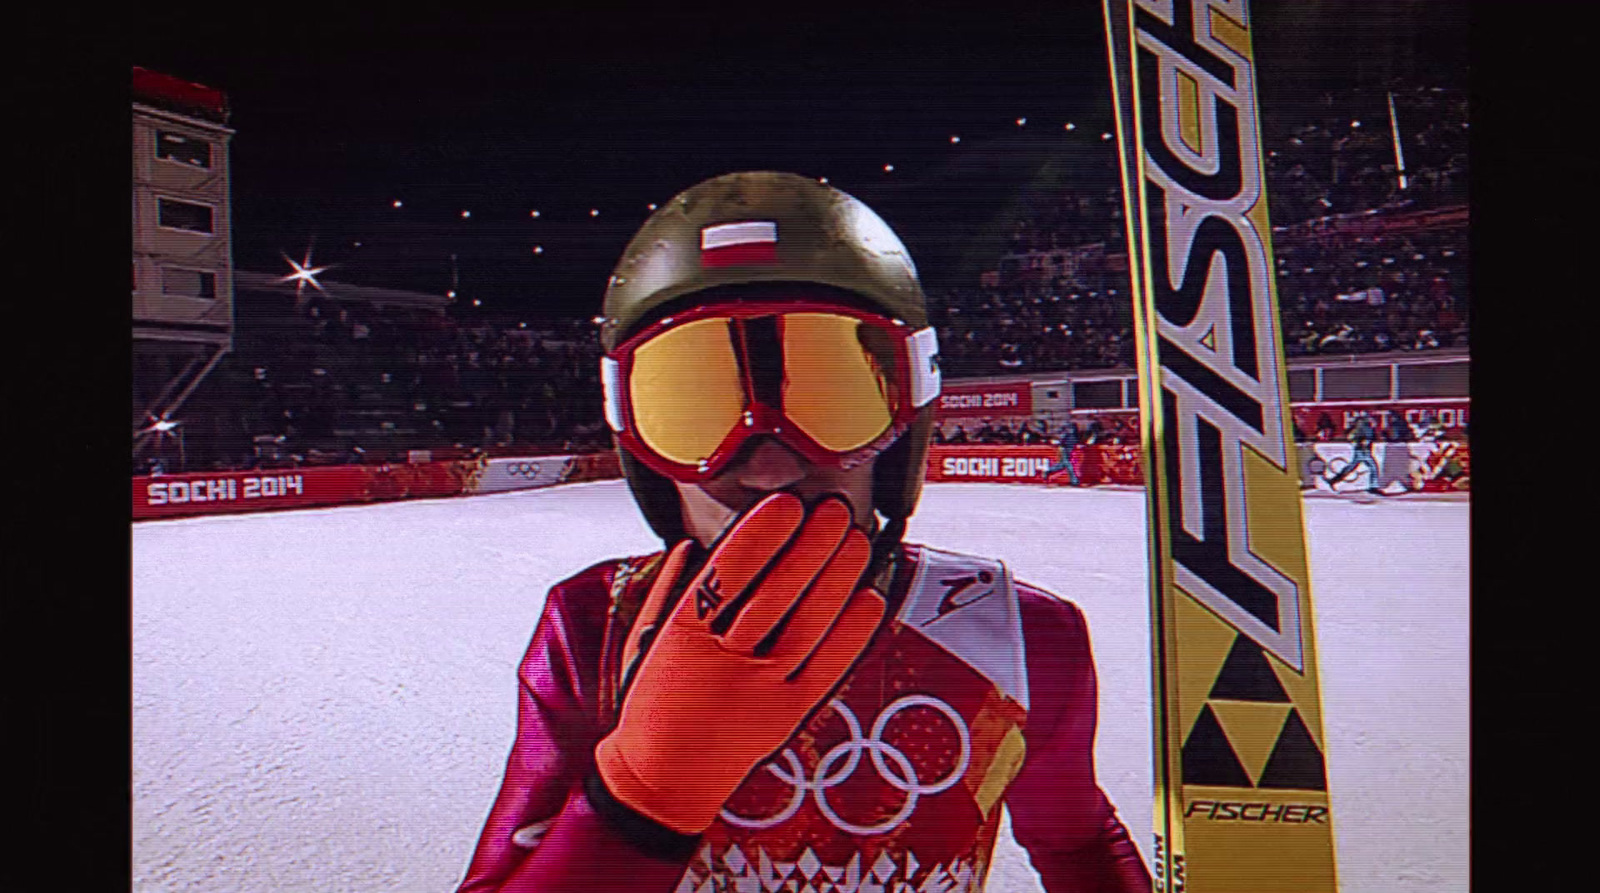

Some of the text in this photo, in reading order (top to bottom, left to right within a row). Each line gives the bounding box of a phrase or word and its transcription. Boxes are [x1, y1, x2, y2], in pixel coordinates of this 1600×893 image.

[940, 392, 1018, 409] SOCHI 2014
[943, 457, 1049, 479] SOCHI 2014
[147, 474, 303, 505] SOCHI 2014
[1183, 800, 1328, 824] FISCHER
